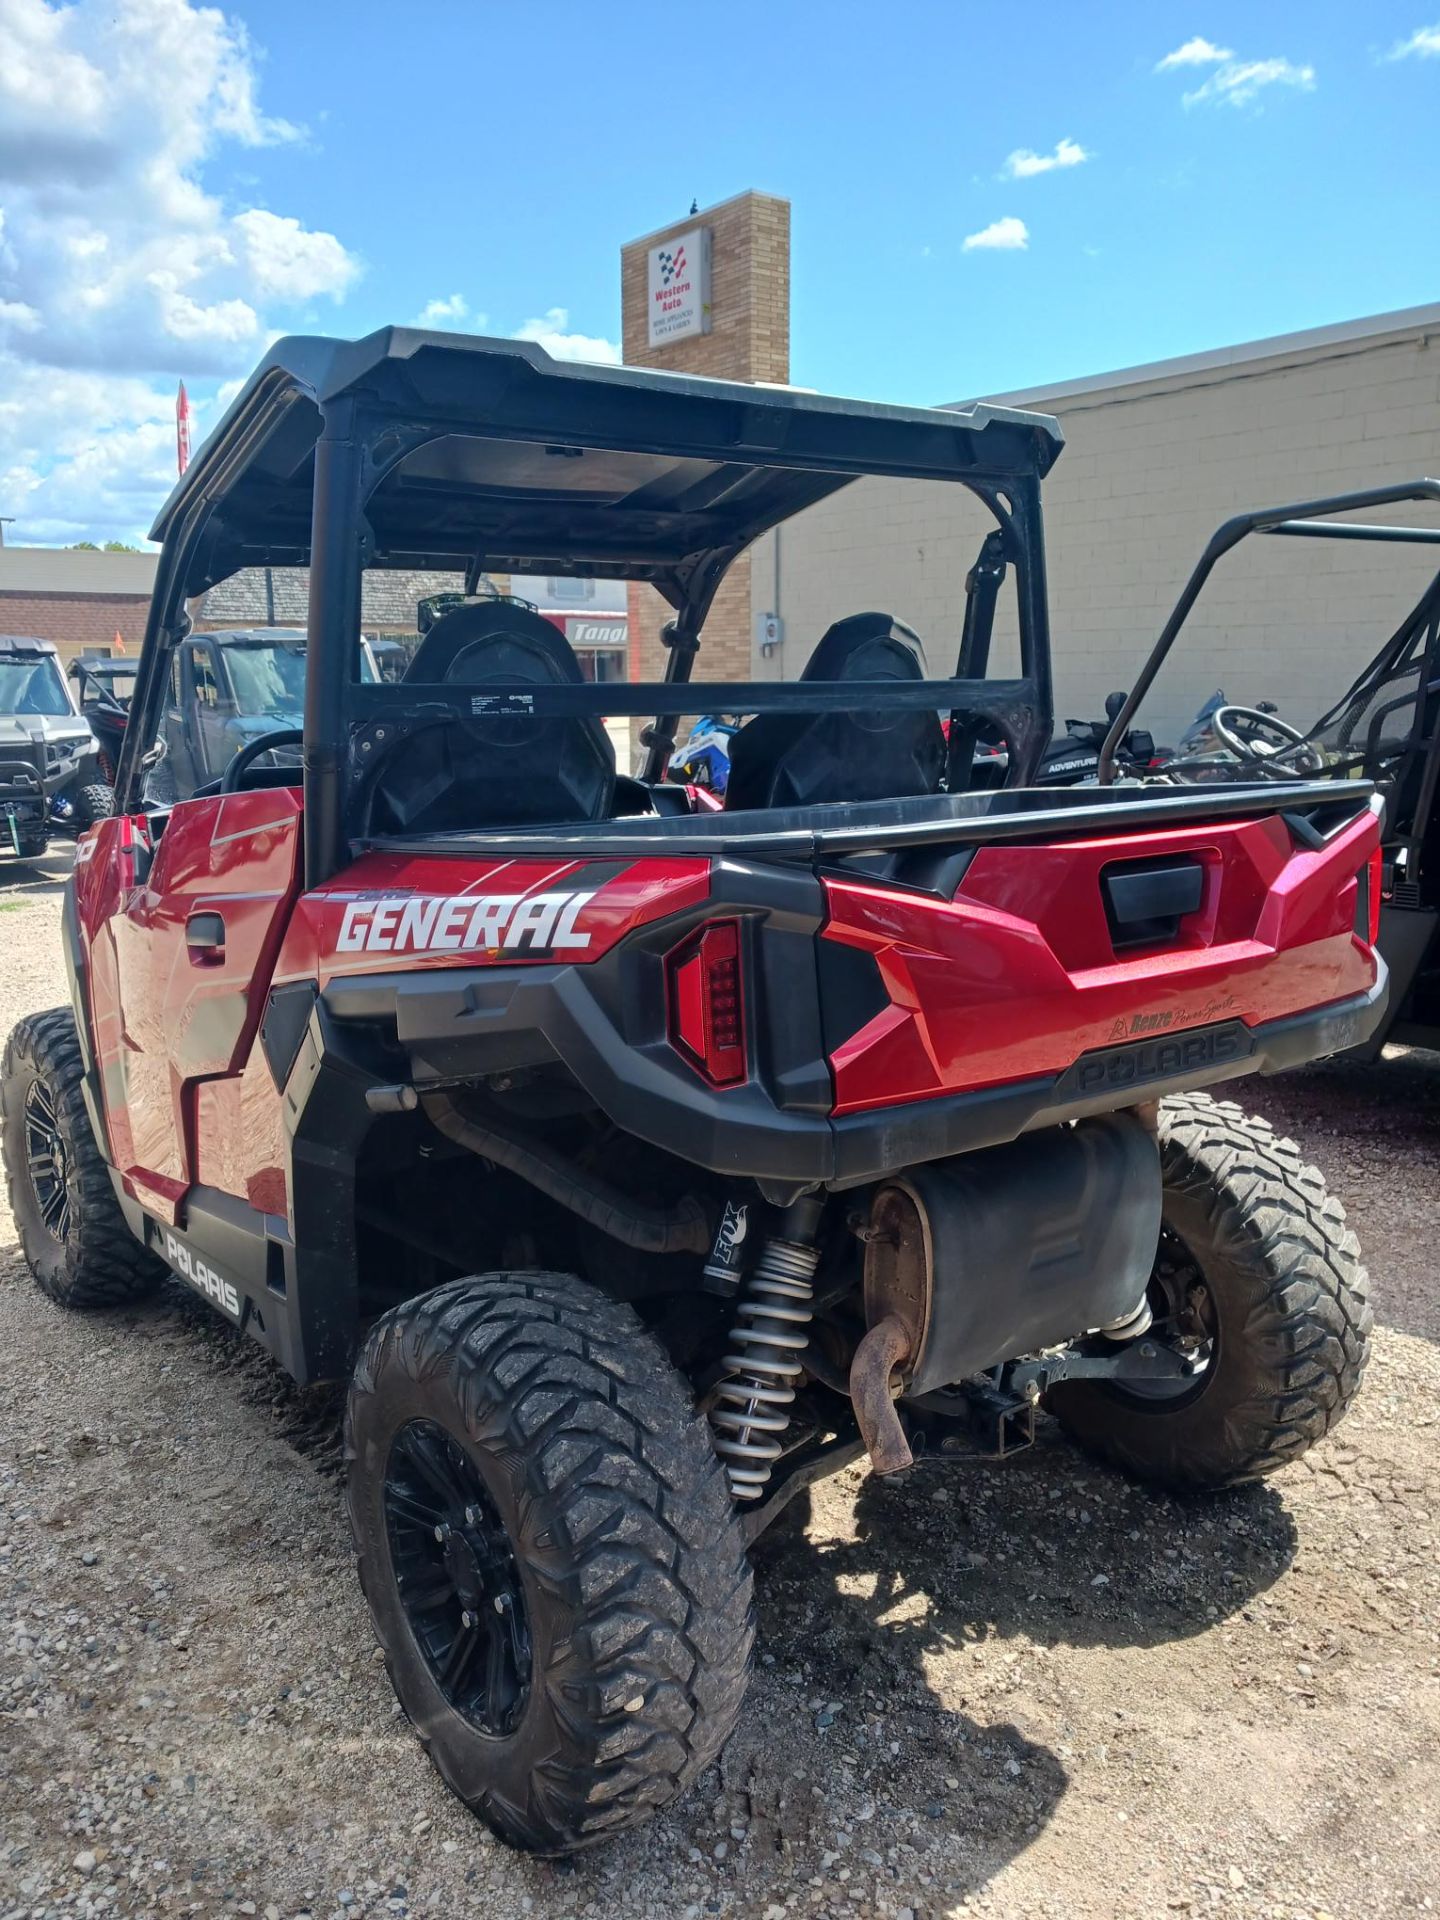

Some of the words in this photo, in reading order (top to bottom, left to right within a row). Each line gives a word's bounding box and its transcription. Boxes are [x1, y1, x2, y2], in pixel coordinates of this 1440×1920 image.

[655, 282, 690, 301] Western
[662, 298, 682, 312] Auto
[1048, 756, 1098, 773] ADVENTURE
[335, 892, 598, 952] GENERAL
[1129, 1010, 1174, 1034] Renze
[1076, 1028, 1238, 1090] POLARIS
[713, 1200, 748, 1264] FOX
[166, 1232, 240, 1316] POLARIS
